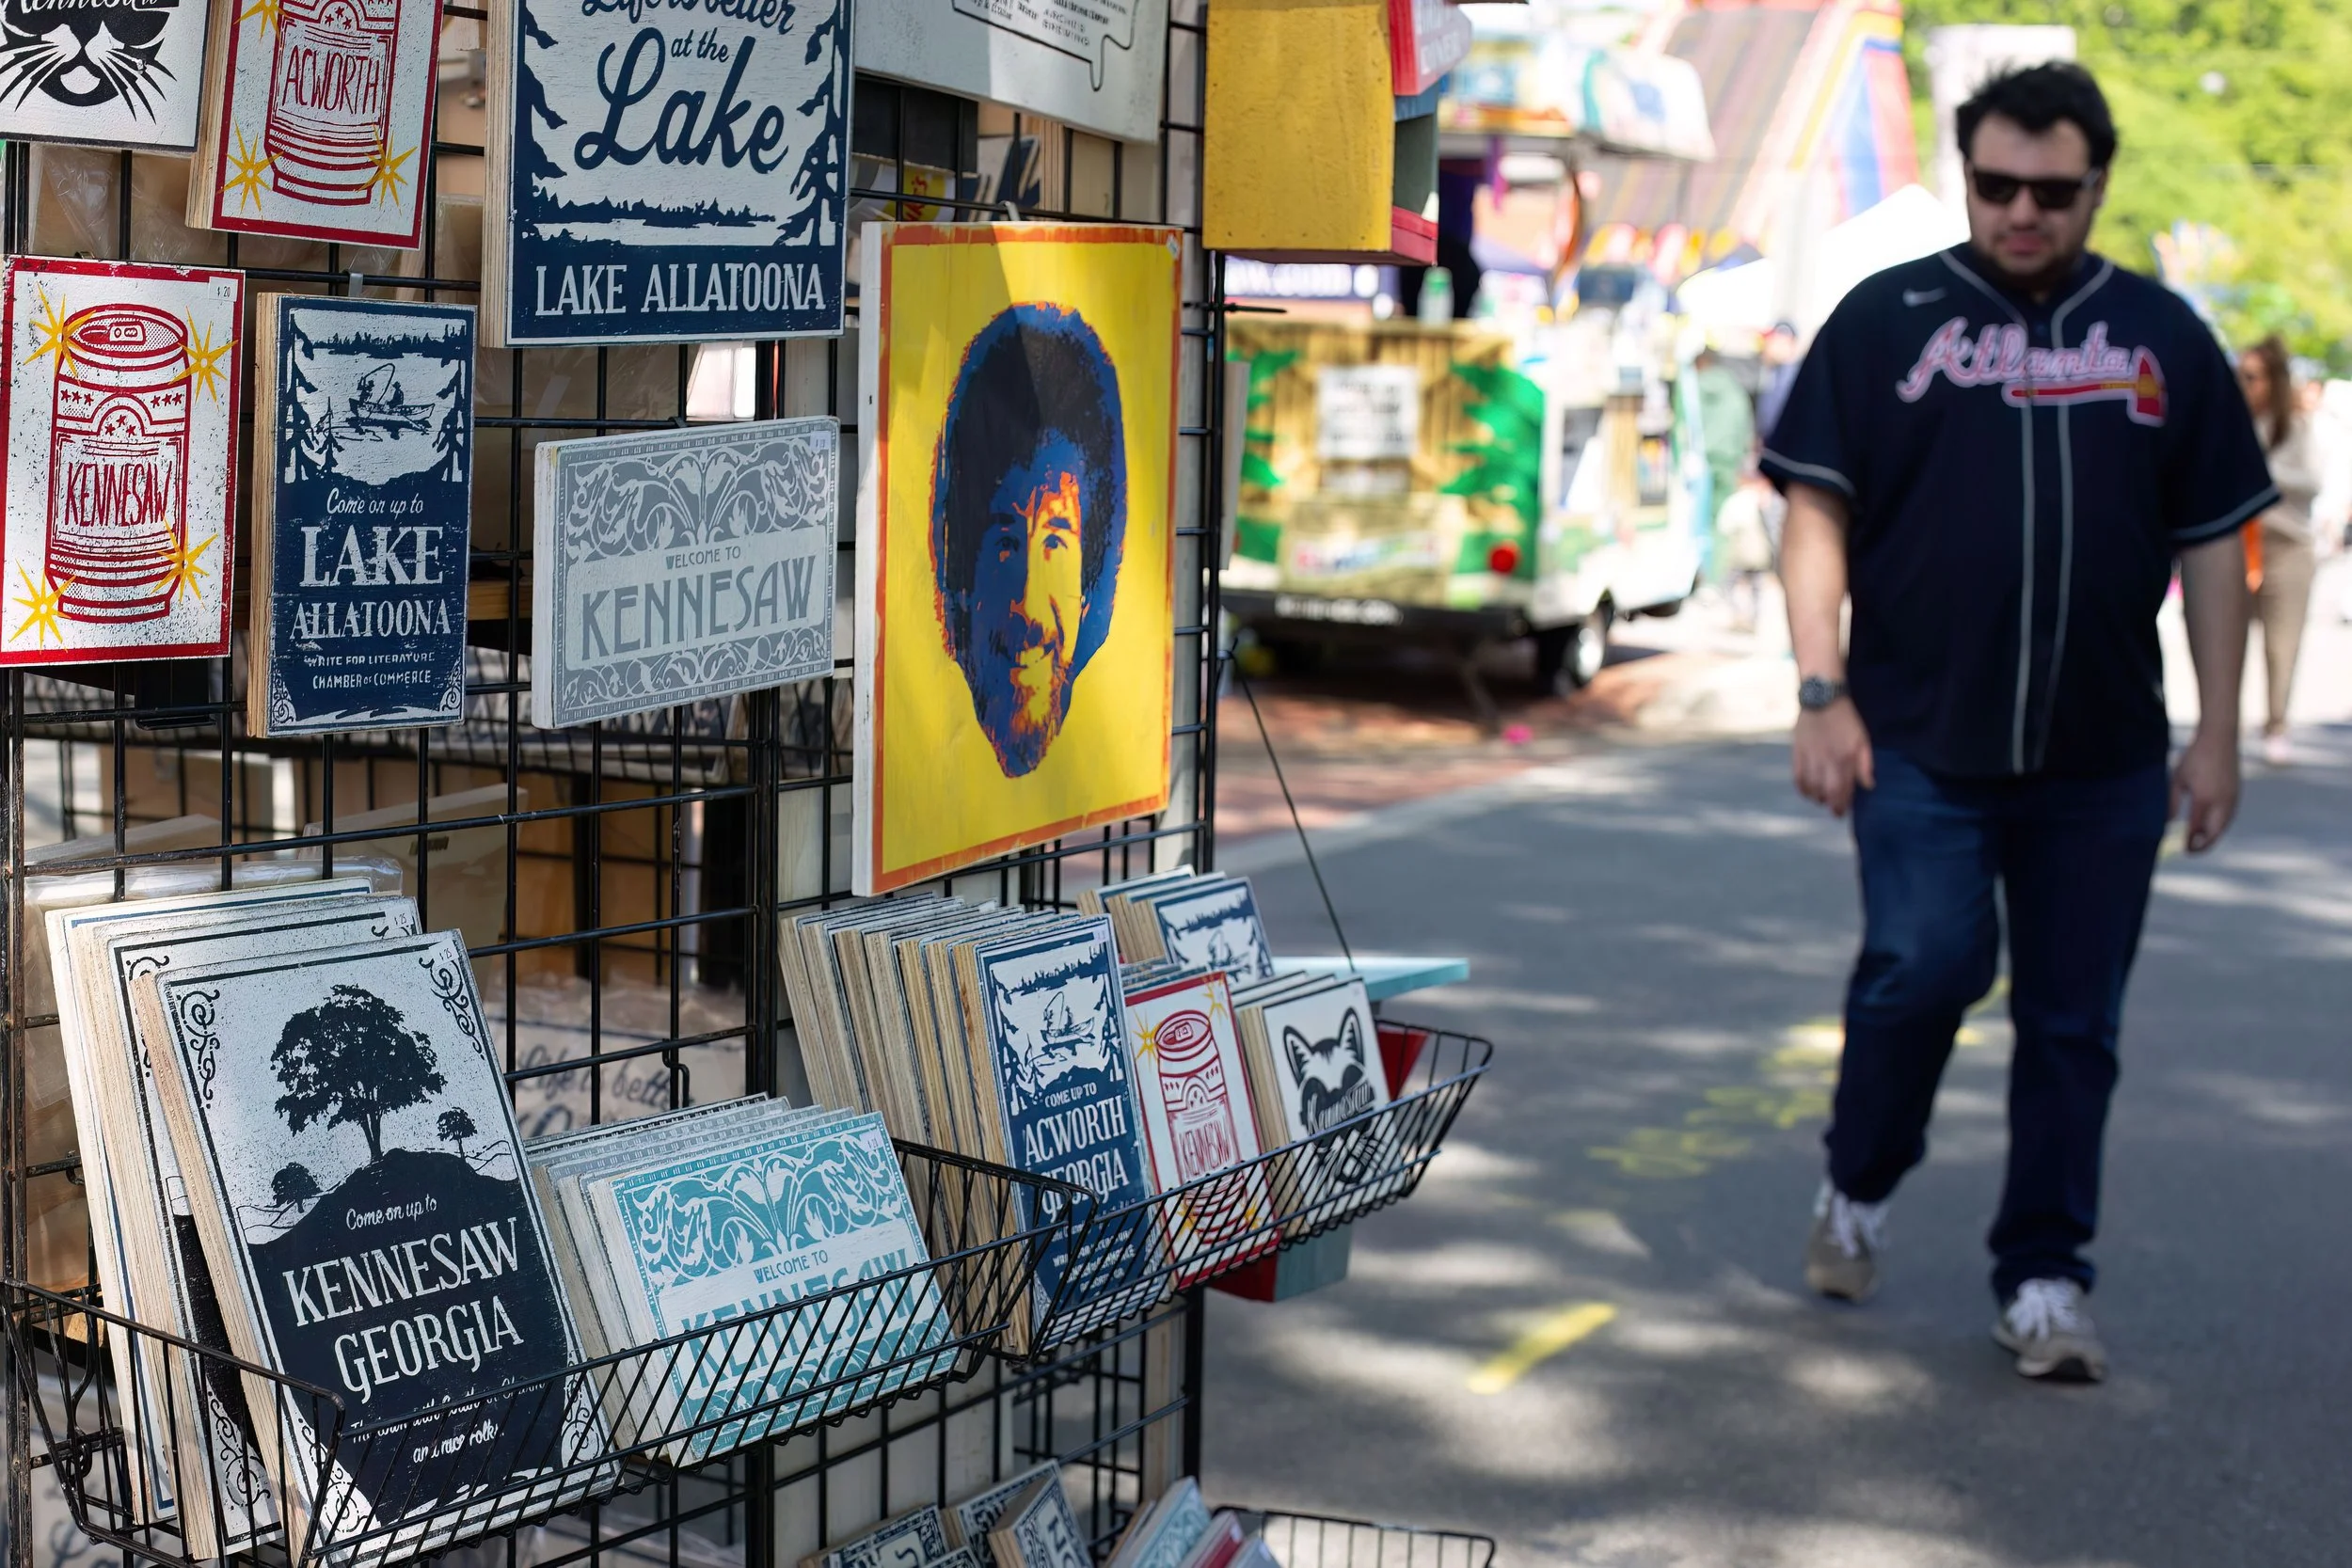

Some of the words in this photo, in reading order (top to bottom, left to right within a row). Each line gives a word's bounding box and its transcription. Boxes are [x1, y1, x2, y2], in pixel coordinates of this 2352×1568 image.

[671, 29, 694, 57] at
[697, 27, 730, 63] the
[282, 45, 380, 115] ACWORTH
[575, 27, 789, 174] Lake
[535, 264, 628, 316] LAKE
[641, 262, 826, 314] ALLATOONA
[1896, 316, 2134, 403] Atlanta
[65, 461, 173, 528] KENNESAW
[326, 487, 365, 514] Come
[368, 500, 385, 514] on
[389, 499, 406, 518] up
[409, 493, 423, 514] to
[299, 525, 444, 587] LAKE
[666, 548, 721, 570] WELCOME
[725, 546, 741, 559] TO
[290, 598, 452, 639] ALLATOONA
[581, 555, 817, 660] KENNESAW
[306, 655, 342, 667] WRITE
[345, 656, 366, 665] FOR
[369, 652, 435, 665] LITERATURE
[312, 674, 362, 689] CHAMBER
[374, 670, 431, 686] COMMERCE
[1044, 1089, 1071, 1108] COME
[1071, 1085, 1083, 1101] UP
[1083, 1082, 1097, 1097] TO
[1025, 1095, 1127, 1166] ACWORTH
[346, 1208, 384, 1229] Come
[385, 1205, 405, 1221] on
[406, 1201, 424, 1222] up
[425, 1193, 437, 1212] to
[1041, 1148, 1130, 1224] GEORGIA
[282, 1216, 518, 1327] KENNESAW
[754, 1257, 810, 1284] WELCOME
[812, 1249, 829, 1264] TO
[681, 1248, 915, 1388] KENNESAW
[334, 1295, 525, 1404] GEORGIA
